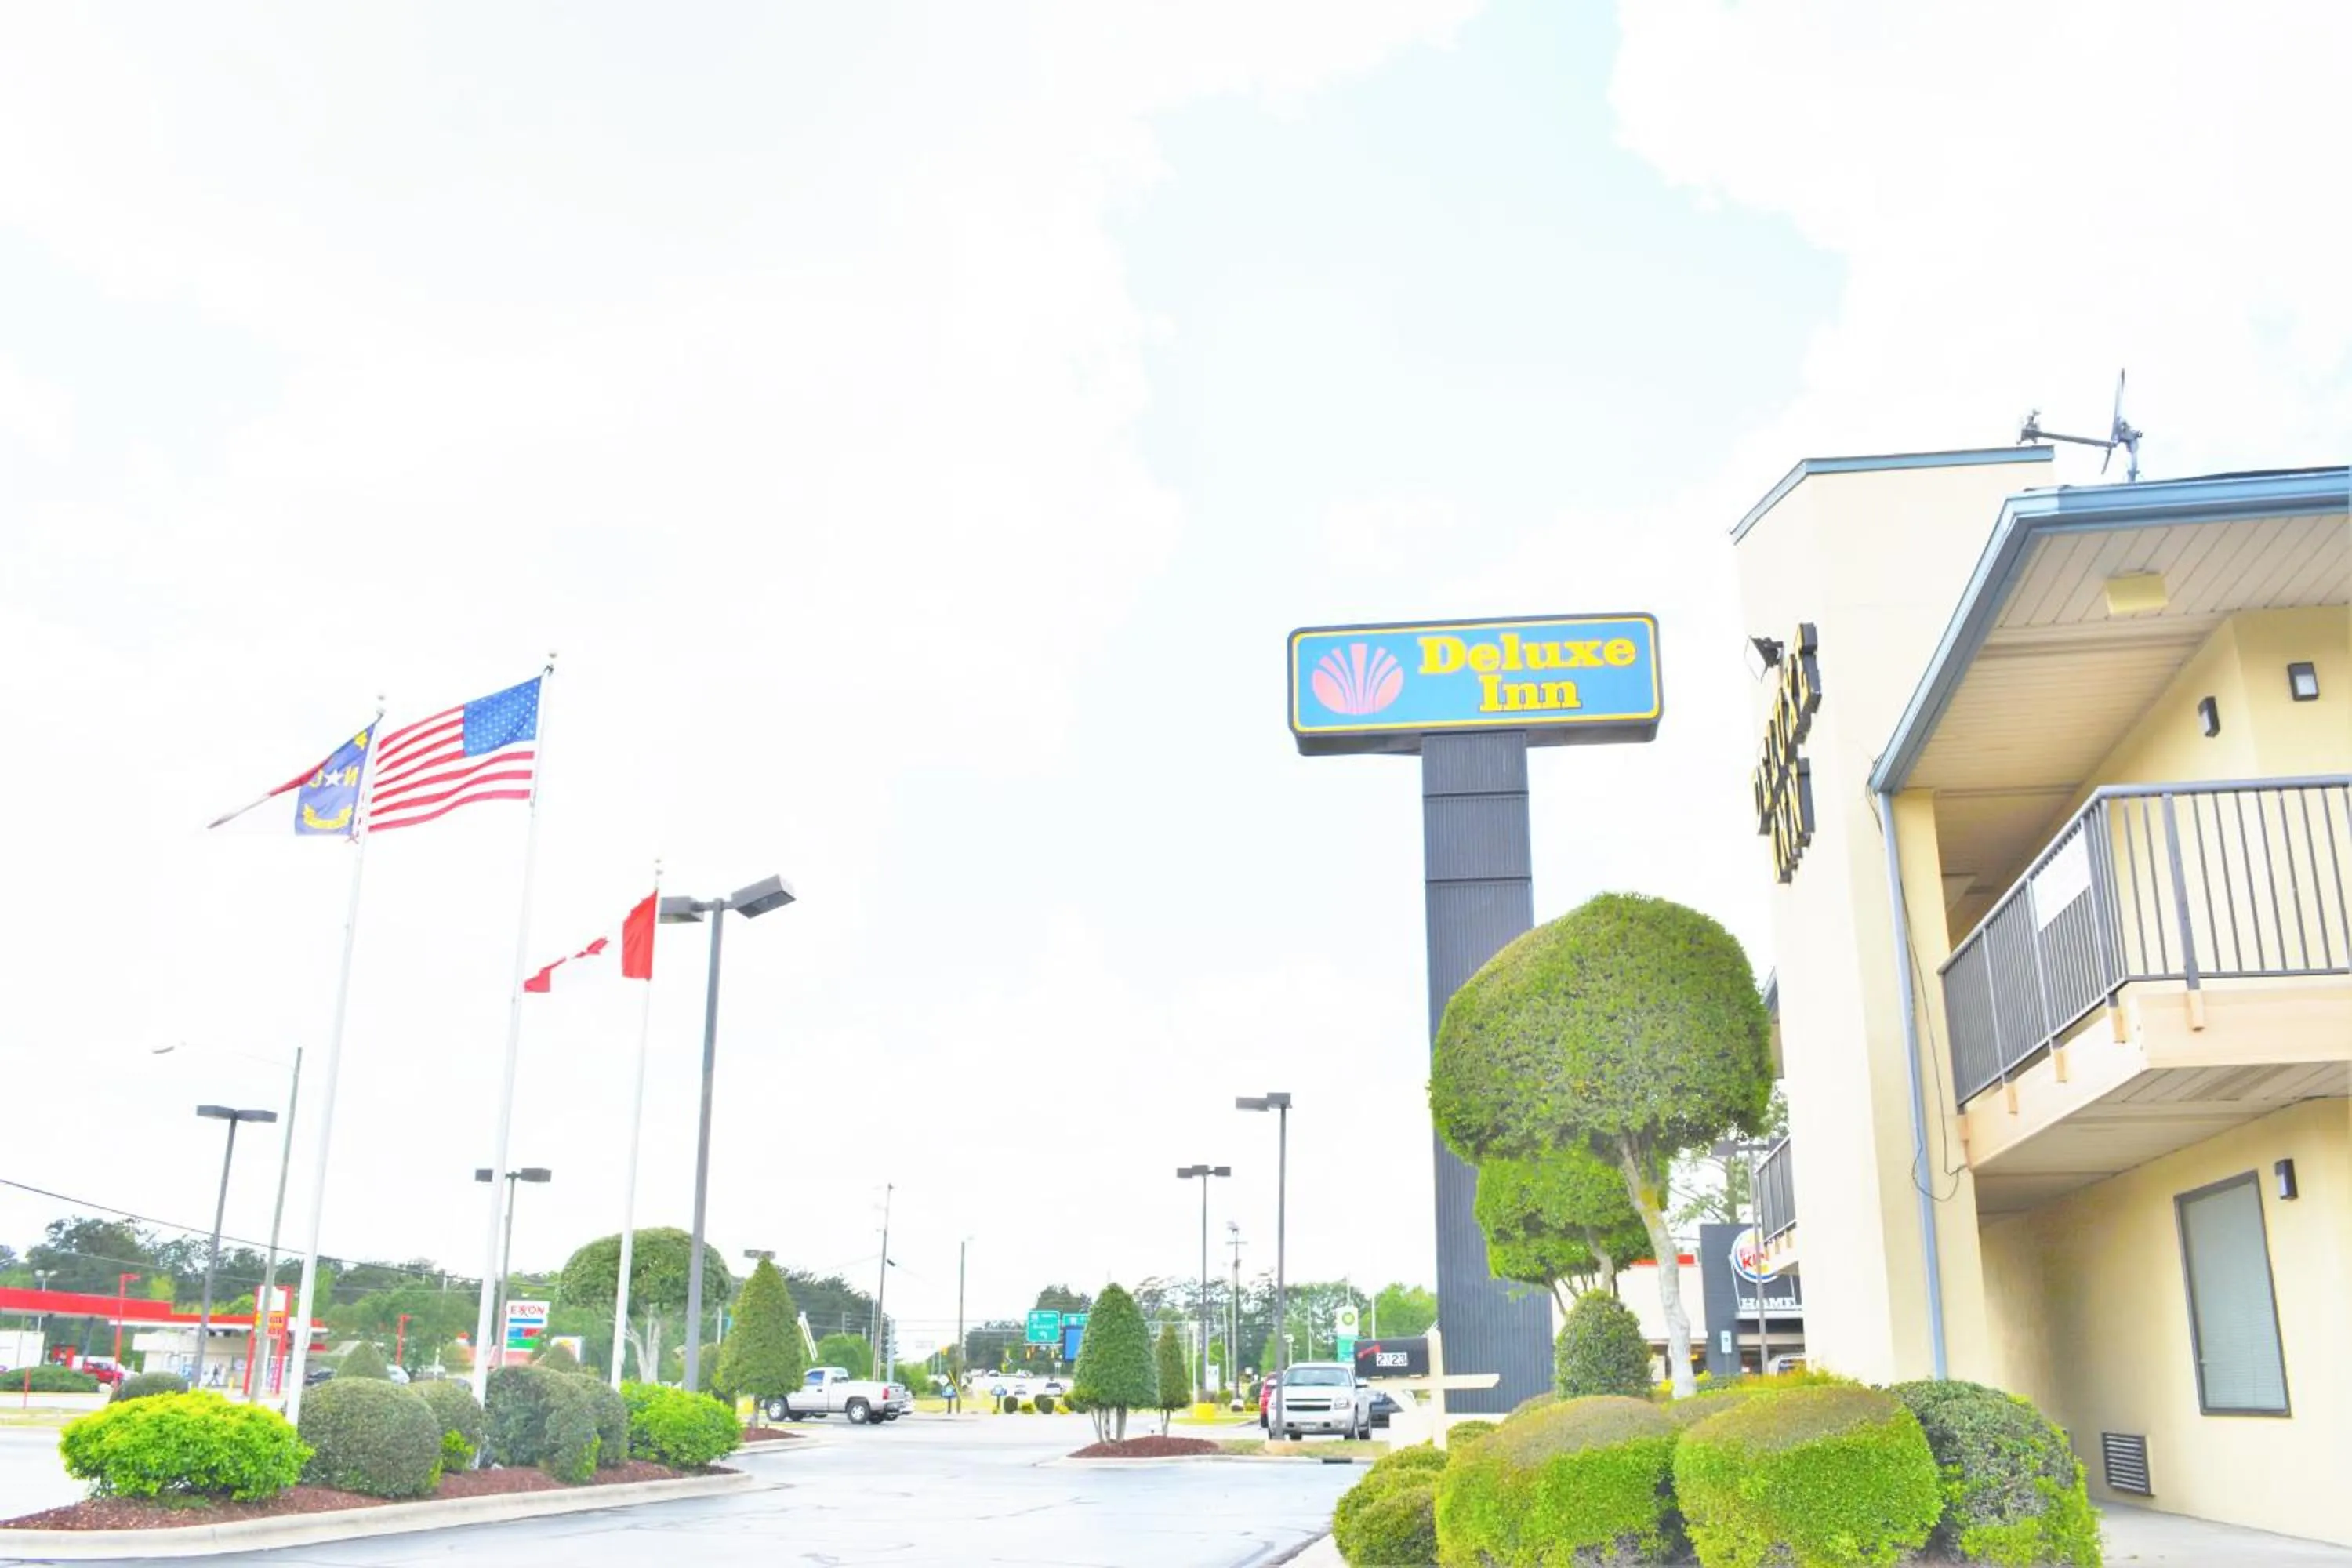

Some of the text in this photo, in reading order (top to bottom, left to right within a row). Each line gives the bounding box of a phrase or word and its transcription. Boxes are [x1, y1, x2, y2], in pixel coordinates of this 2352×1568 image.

[1417, 633, 1637, 674] Deluxe
[1479, 674, 1582, 712] Inn
[1377, 1354, 1406, 1365] 2123
